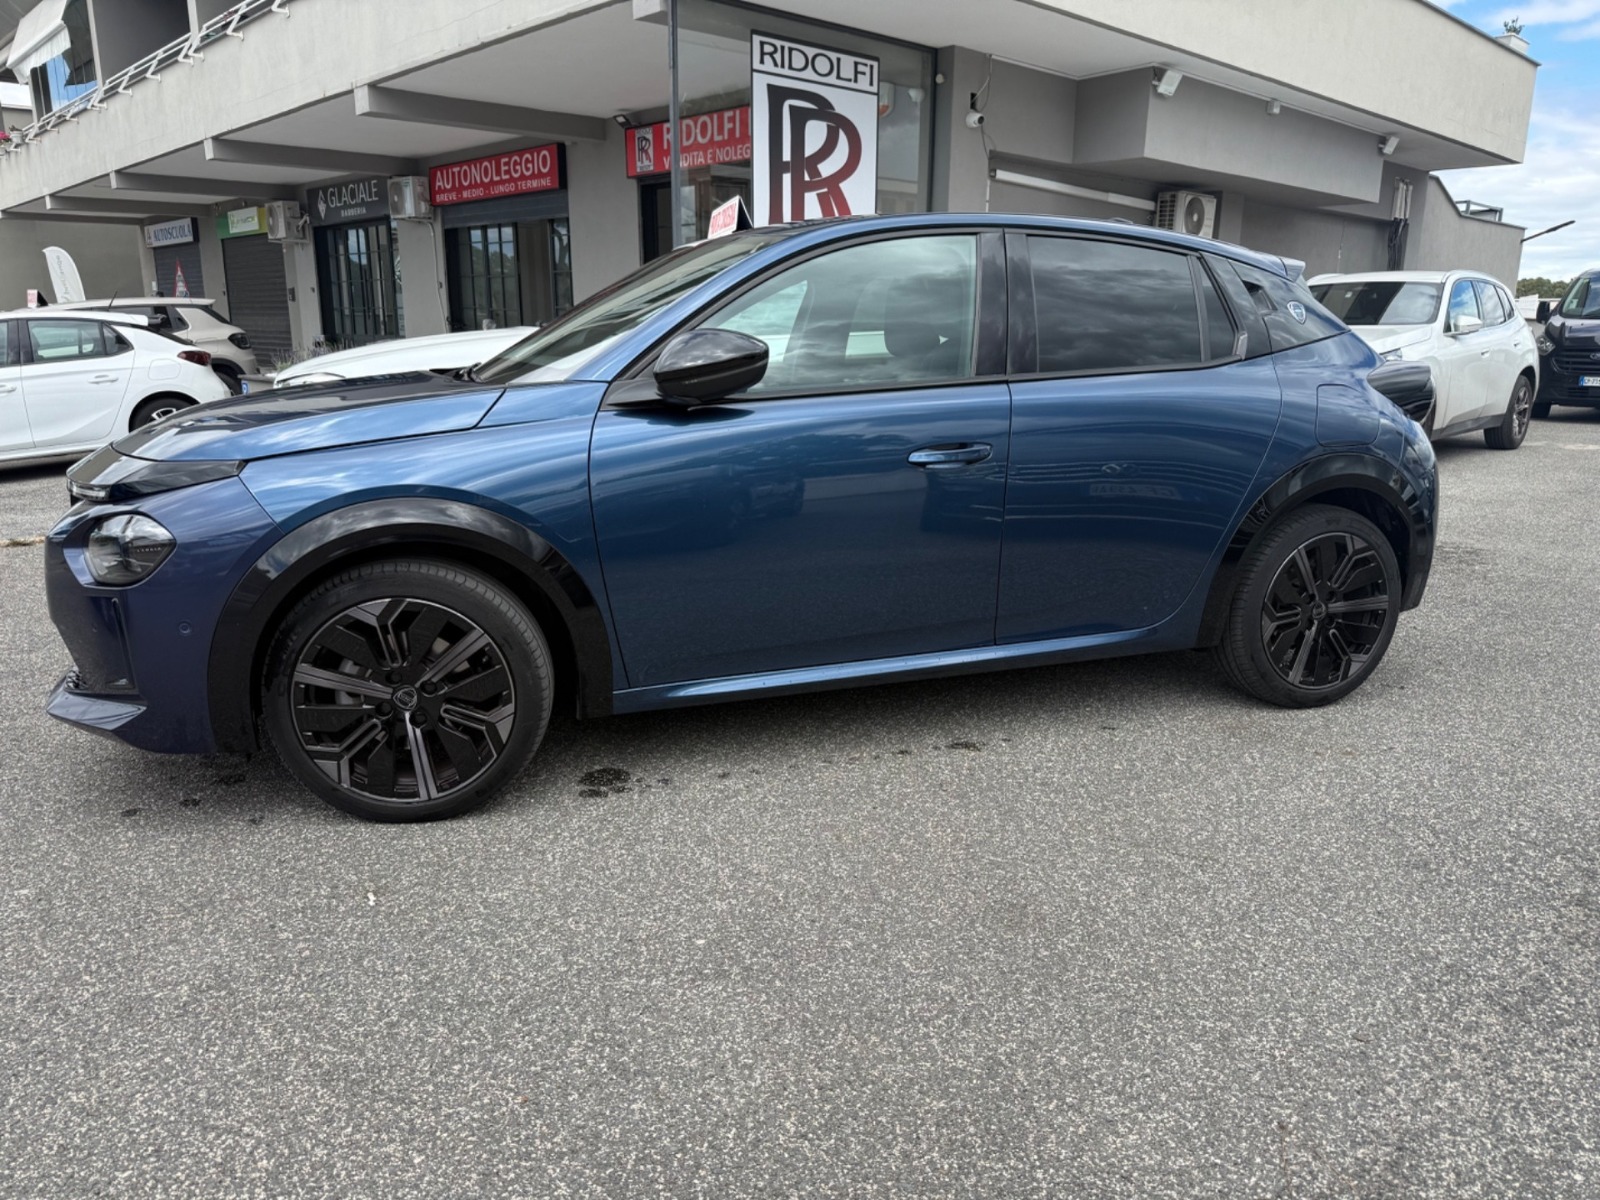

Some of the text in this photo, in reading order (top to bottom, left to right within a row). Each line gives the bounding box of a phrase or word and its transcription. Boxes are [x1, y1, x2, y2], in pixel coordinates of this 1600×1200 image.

[758, 40, 874, 87] RIDOLFI
[663, 110, 740, 150] RDOLFI
[435, 150, 551, 191] AUTONOLEGGIO
[663, 151, 705, 170] VDITA
[707, 149, 714, 164] E
[327, 180, 379, 208] GLACIALE
[435, 191, 458, 203] BREVE
[462, 187, 484, 199] MEDIO
[490, 182, 516, 195] LUNGO
[517, 177, 552, 190] TERMINE
